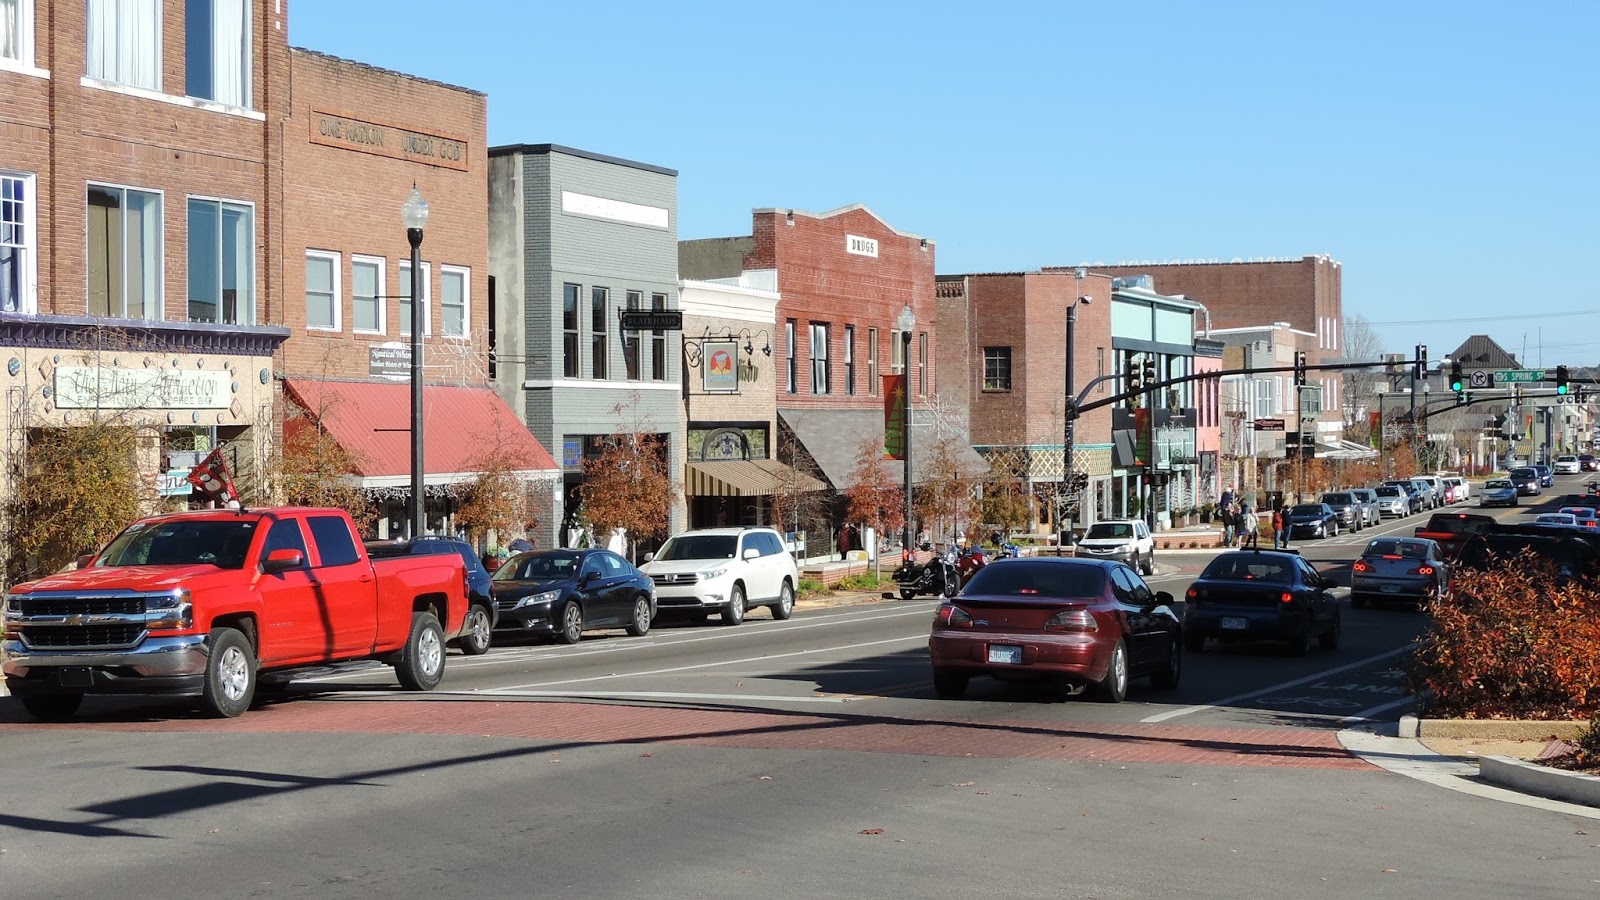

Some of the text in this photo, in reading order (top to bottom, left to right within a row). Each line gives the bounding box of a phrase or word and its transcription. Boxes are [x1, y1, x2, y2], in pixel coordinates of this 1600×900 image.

[319, 119, 460, 161] ONE NATION UNDER GOD
[852, 239, 874, 253] DRUGS
[1503, 372, 1508, 381] S
[1511, 372, 1533, 381] SPRING
